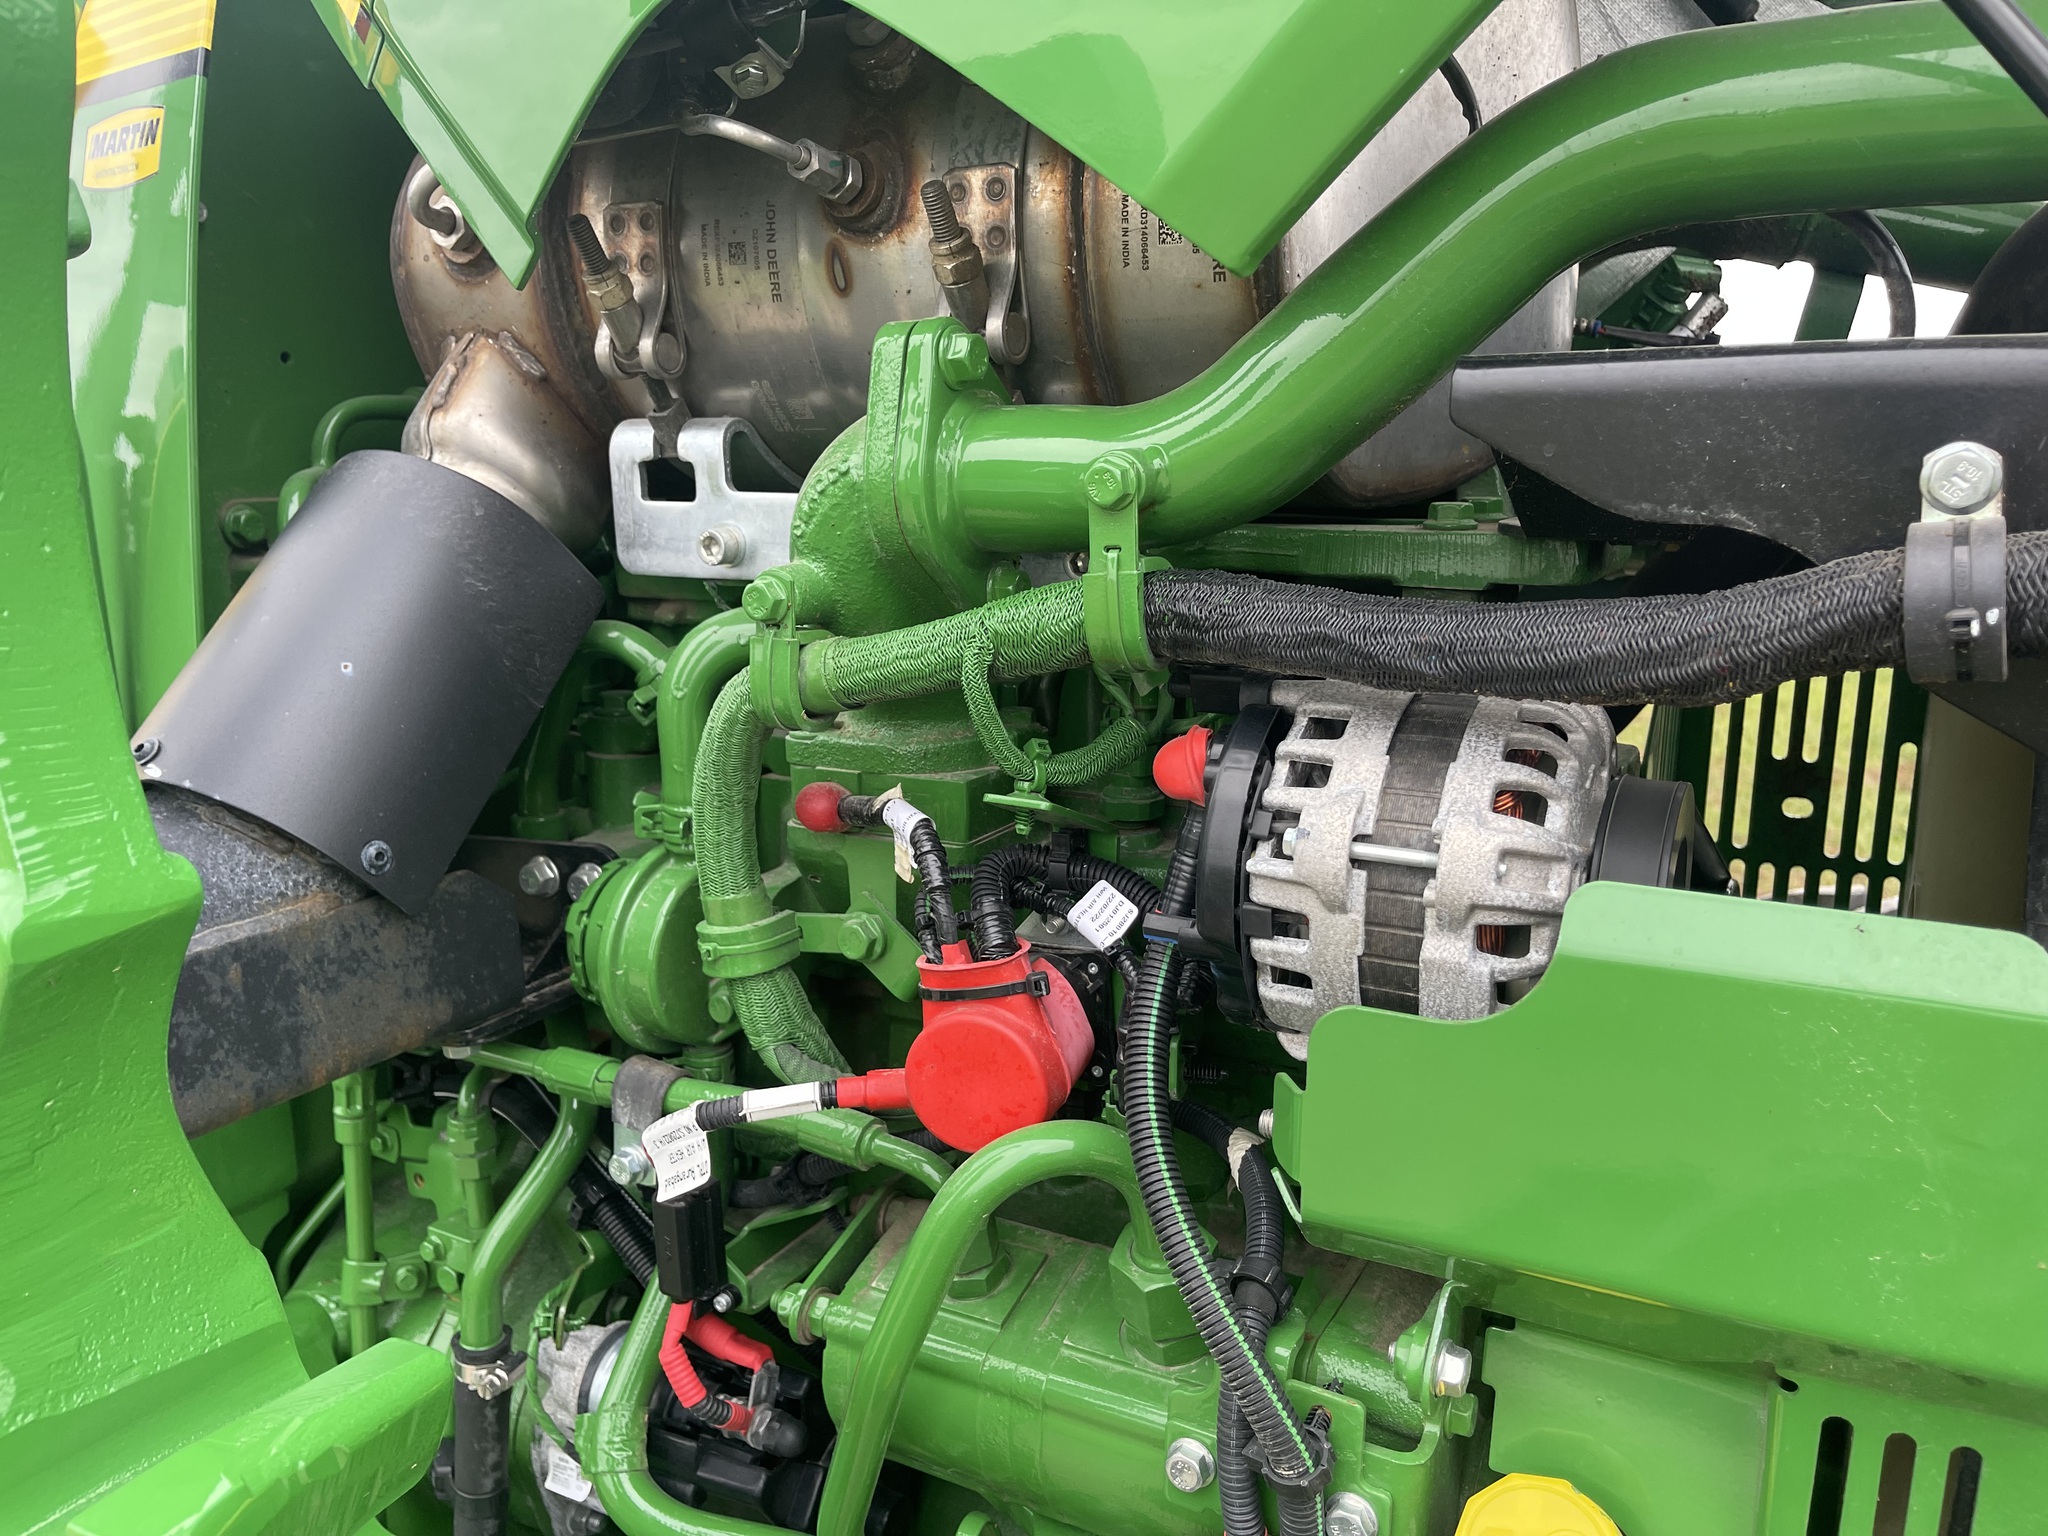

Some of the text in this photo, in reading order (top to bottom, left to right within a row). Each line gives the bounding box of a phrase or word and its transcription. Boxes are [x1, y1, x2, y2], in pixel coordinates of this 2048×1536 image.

[89, 116, 160, 159] MARTIN
[701, 223, 711, 287] MADE IN INDIA
[765, 200, 783, 303] JOHN DEERE
[1121, 194, 1131, 269] MADE IN INDIA
[1090, 892, 1117, 923] 22/02/22
